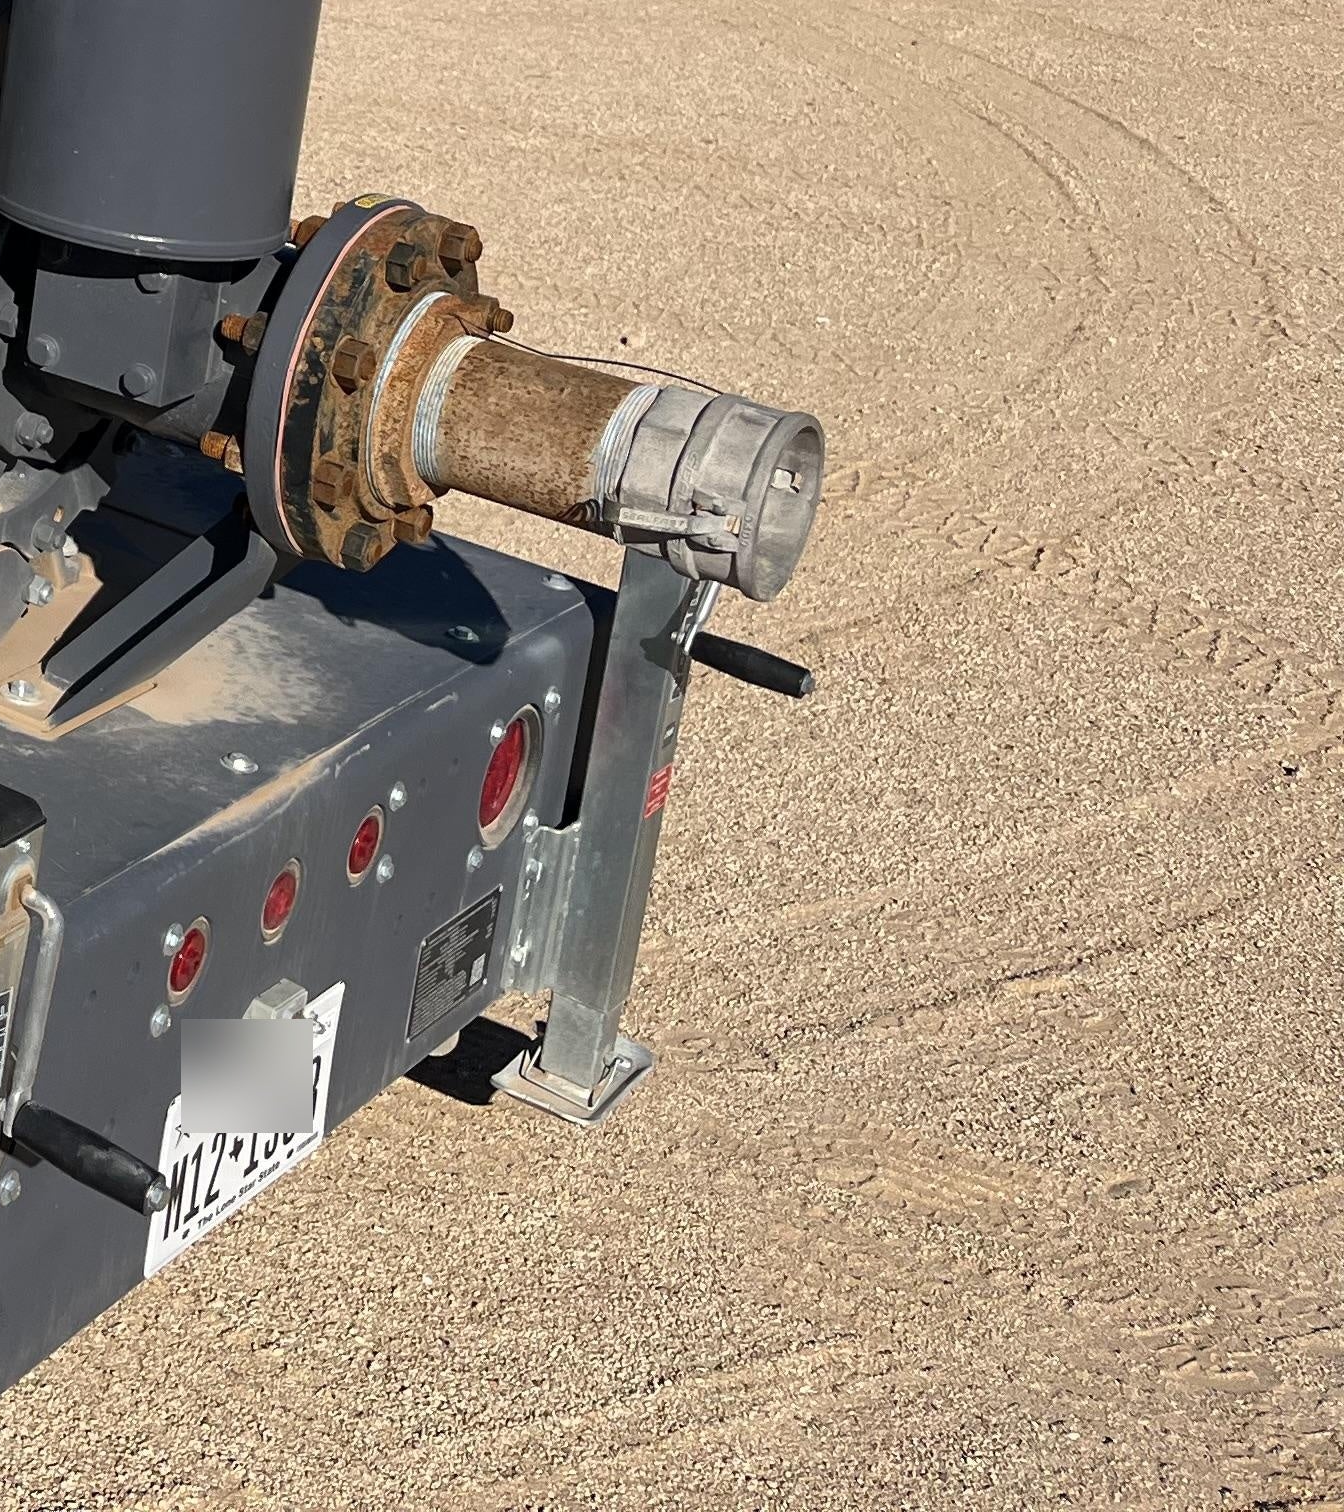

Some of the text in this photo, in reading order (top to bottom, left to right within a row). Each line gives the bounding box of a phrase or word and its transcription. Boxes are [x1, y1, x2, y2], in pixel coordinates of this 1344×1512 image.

[198, 1161, 281, 1230] The Lone Star State
